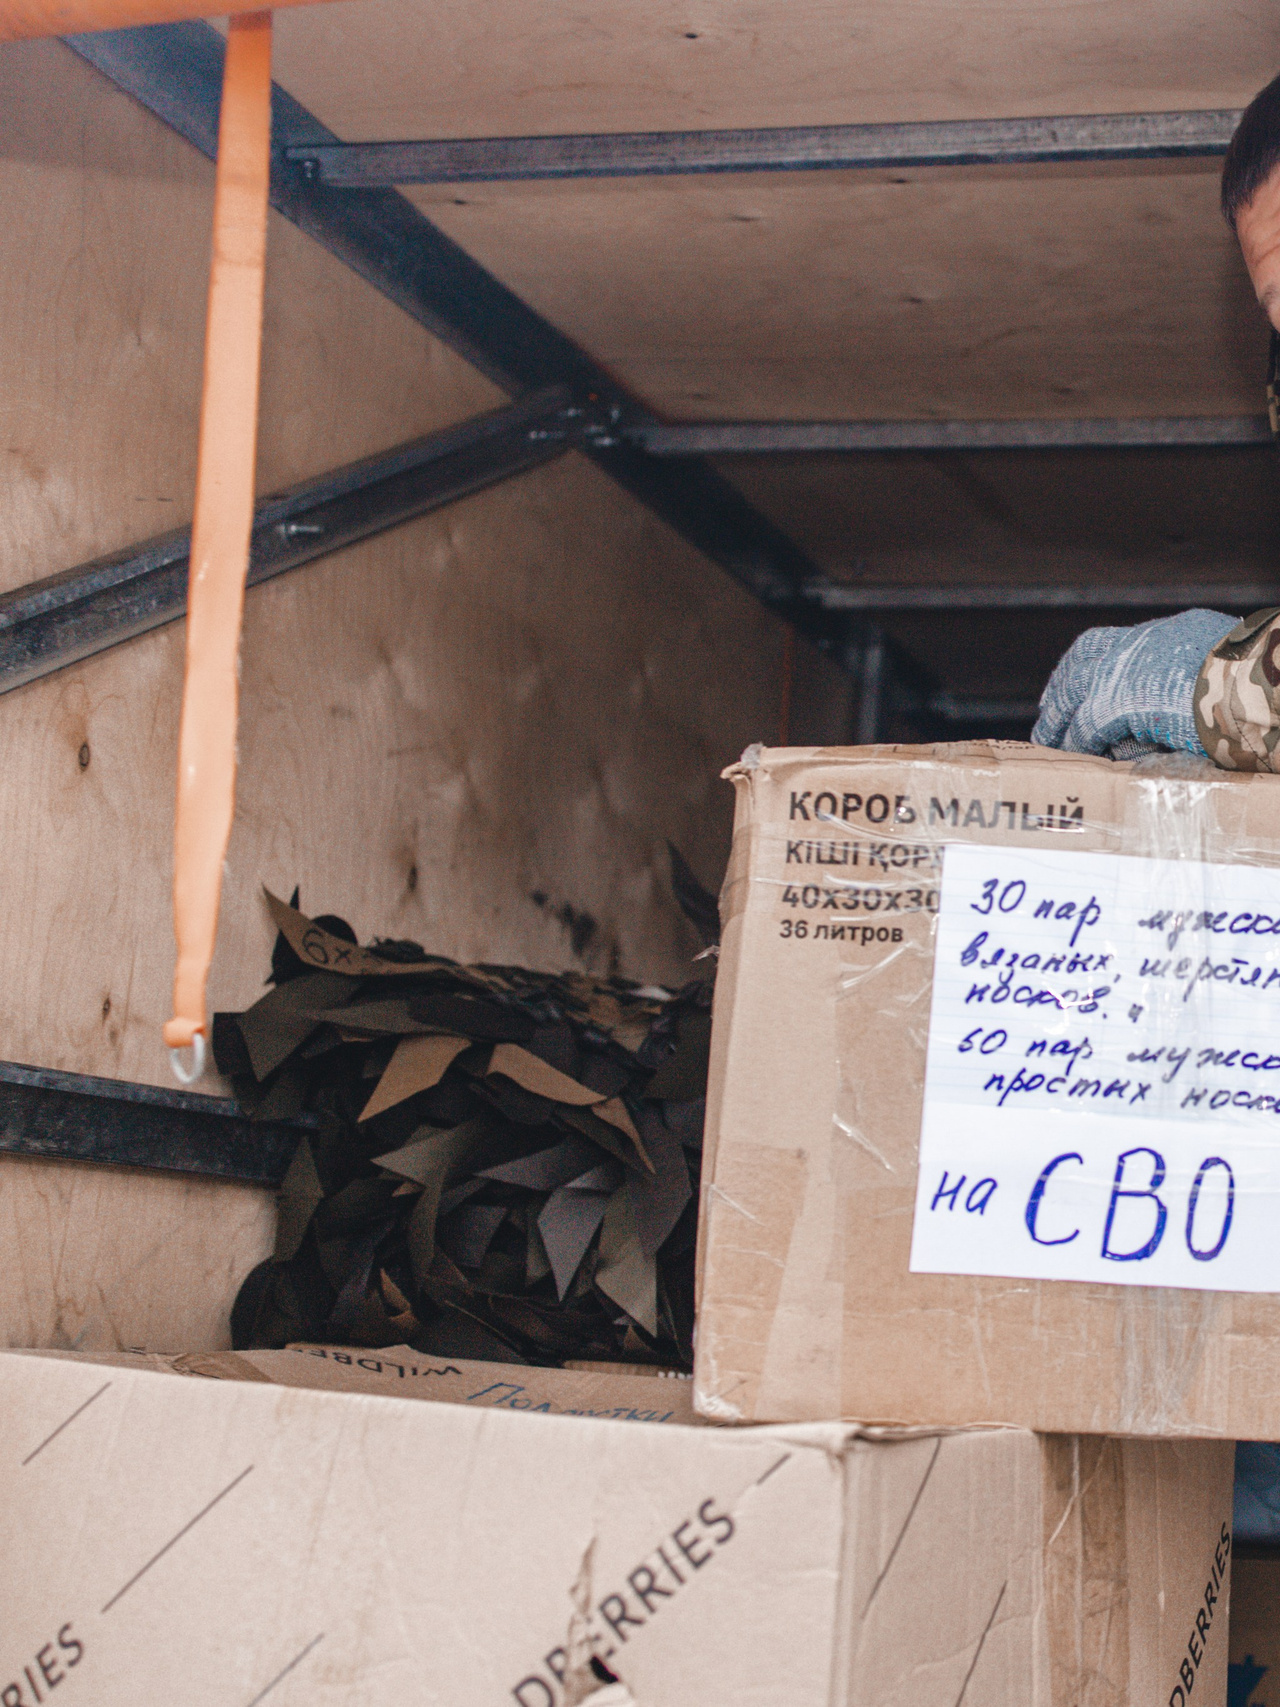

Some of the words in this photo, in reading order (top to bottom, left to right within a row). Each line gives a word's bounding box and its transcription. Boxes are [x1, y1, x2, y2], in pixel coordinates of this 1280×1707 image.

[788, 791, 917, 824] КОРОБ
[928, 796, 1085, 831] МАЛЫЙ
[785, 840, 859, 866] КІШІ
[779, 919, 809, 939] 36
[813, 923, 904, 946] литров
[970, 878, 1026, 915] 30
[1033, 896, 1101, 947] пар
[1025, 1037, 1094, 1076] пар
[983, 1067, 1152, 1107] простых
[930, 1171, 998, 1215] на
[1025, 1147, 1235, 1261] СВО
